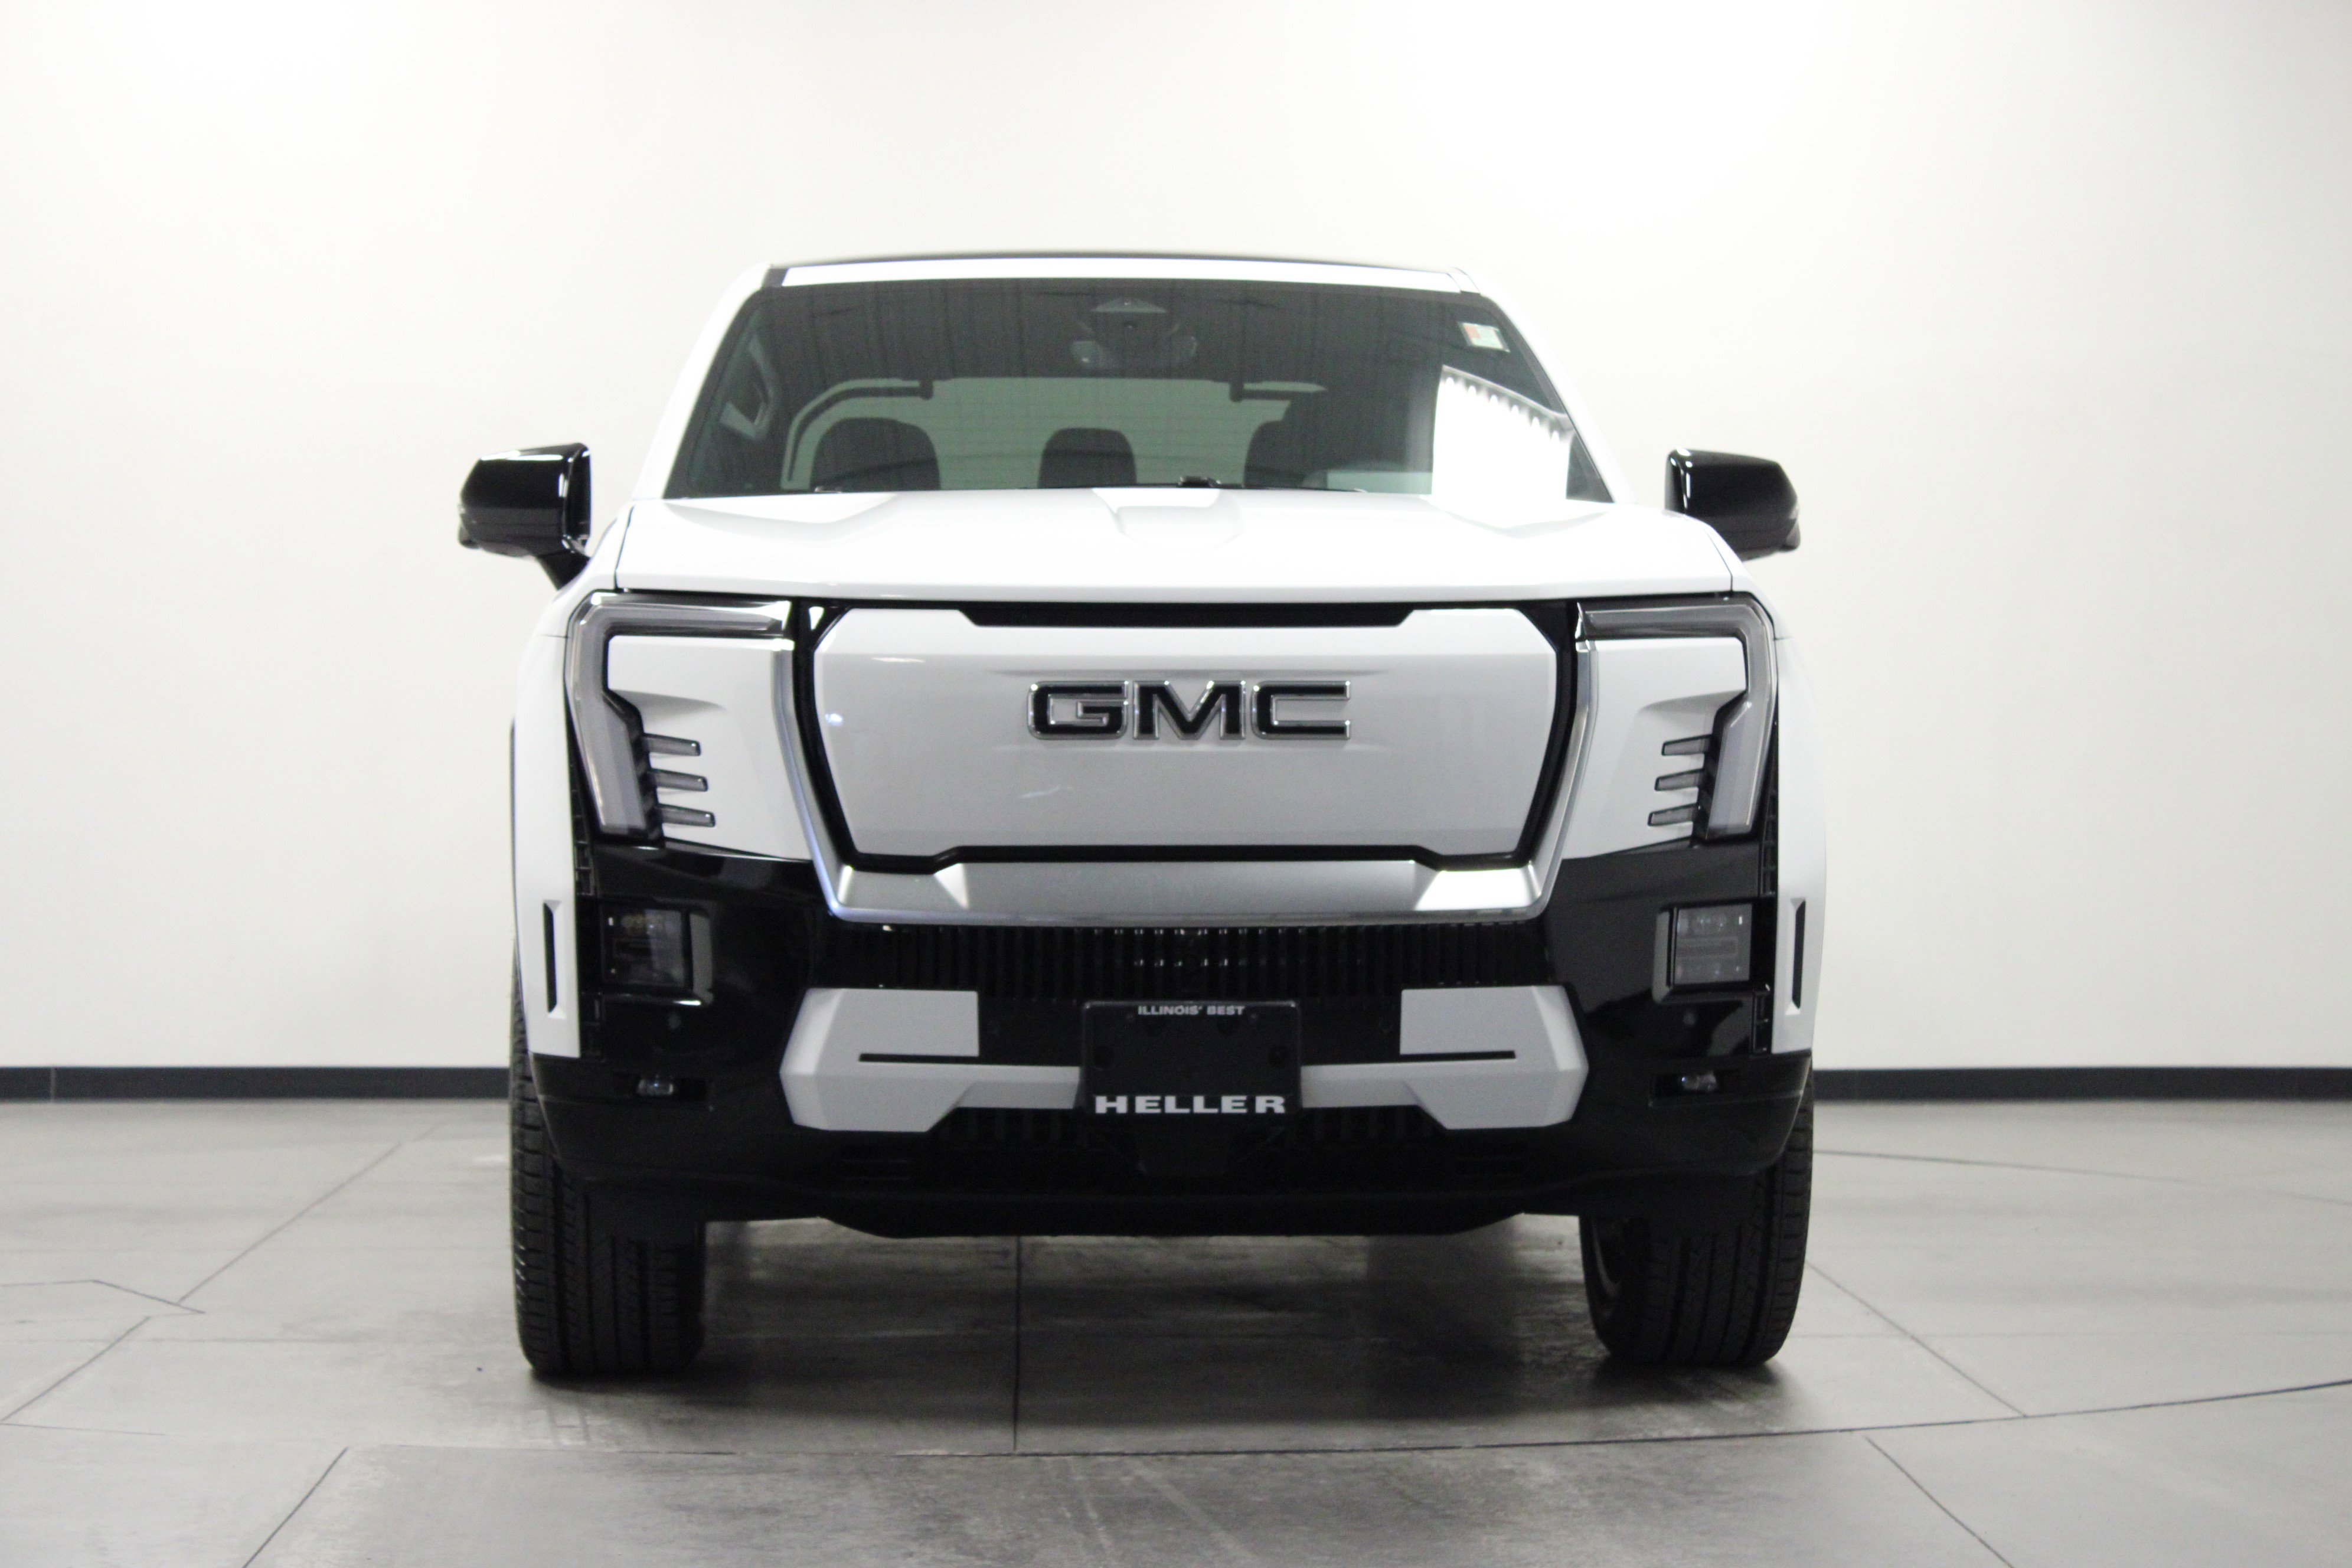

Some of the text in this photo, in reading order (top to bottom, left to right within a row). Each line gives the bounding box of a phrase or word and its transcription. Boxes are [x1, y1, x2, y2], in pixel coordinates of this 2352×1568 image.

[1027, 680, 1351, 740] GMC
[1207, 1005, 1246, 1015] BEST
[1095, 1095, 1285, 1114] HELLER
